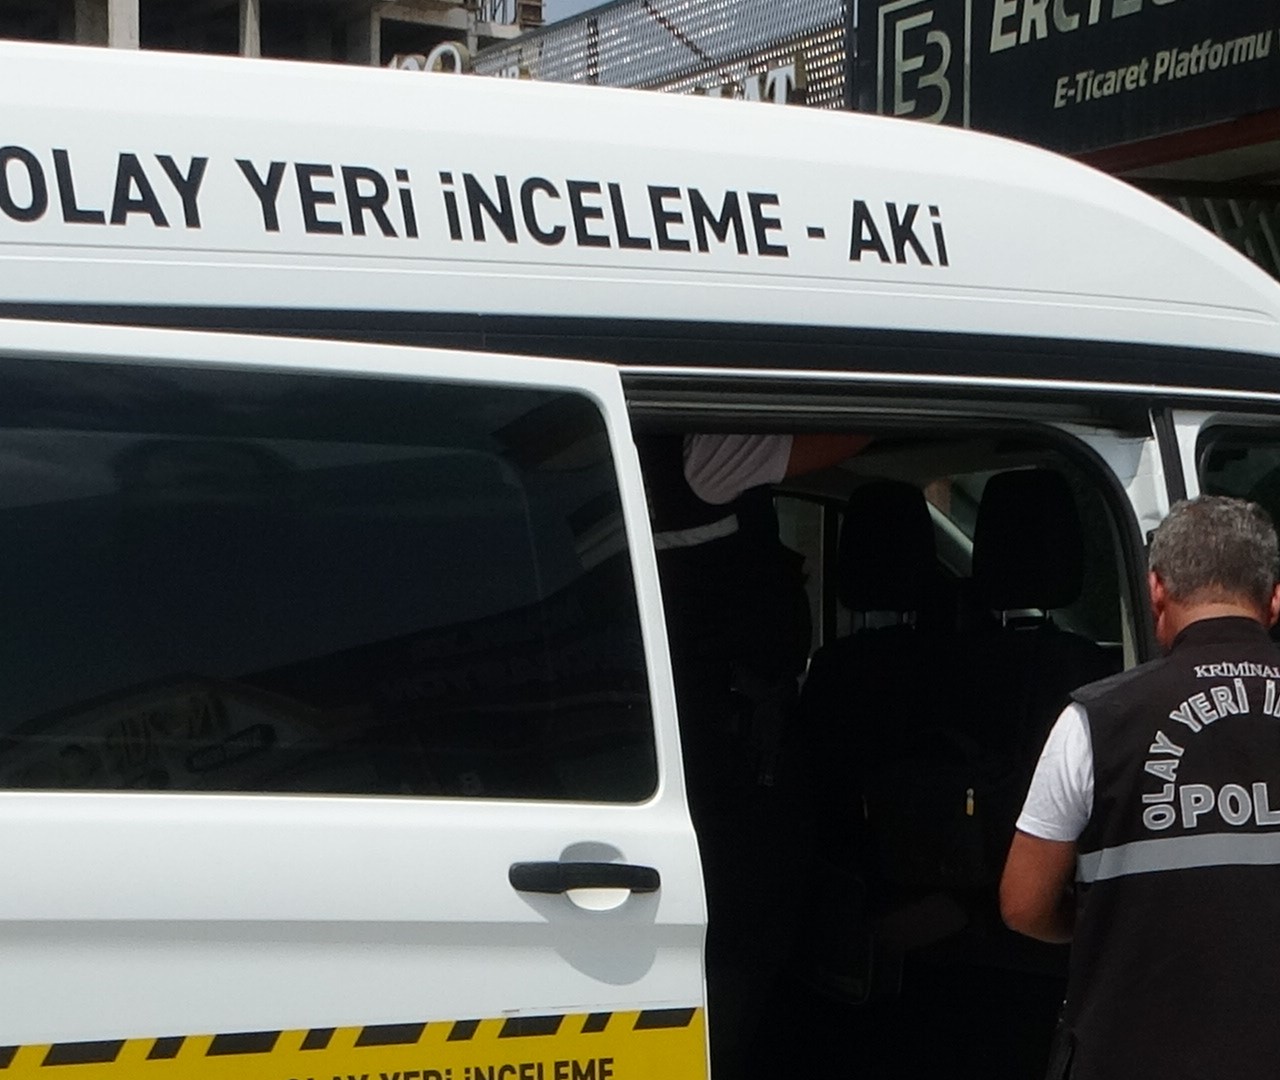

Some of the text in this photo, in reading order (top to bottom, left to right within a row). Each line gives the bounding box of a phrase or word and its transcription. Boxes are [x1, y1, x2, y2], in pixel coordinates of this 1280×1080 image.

[1053, 57, 1150, 109] E-Ticaret
[1152, 30, 1273, 85] Platformu
[1141, 730, 1185, 831] OLAY
[1169, 677, 1250, 734] YERİ
